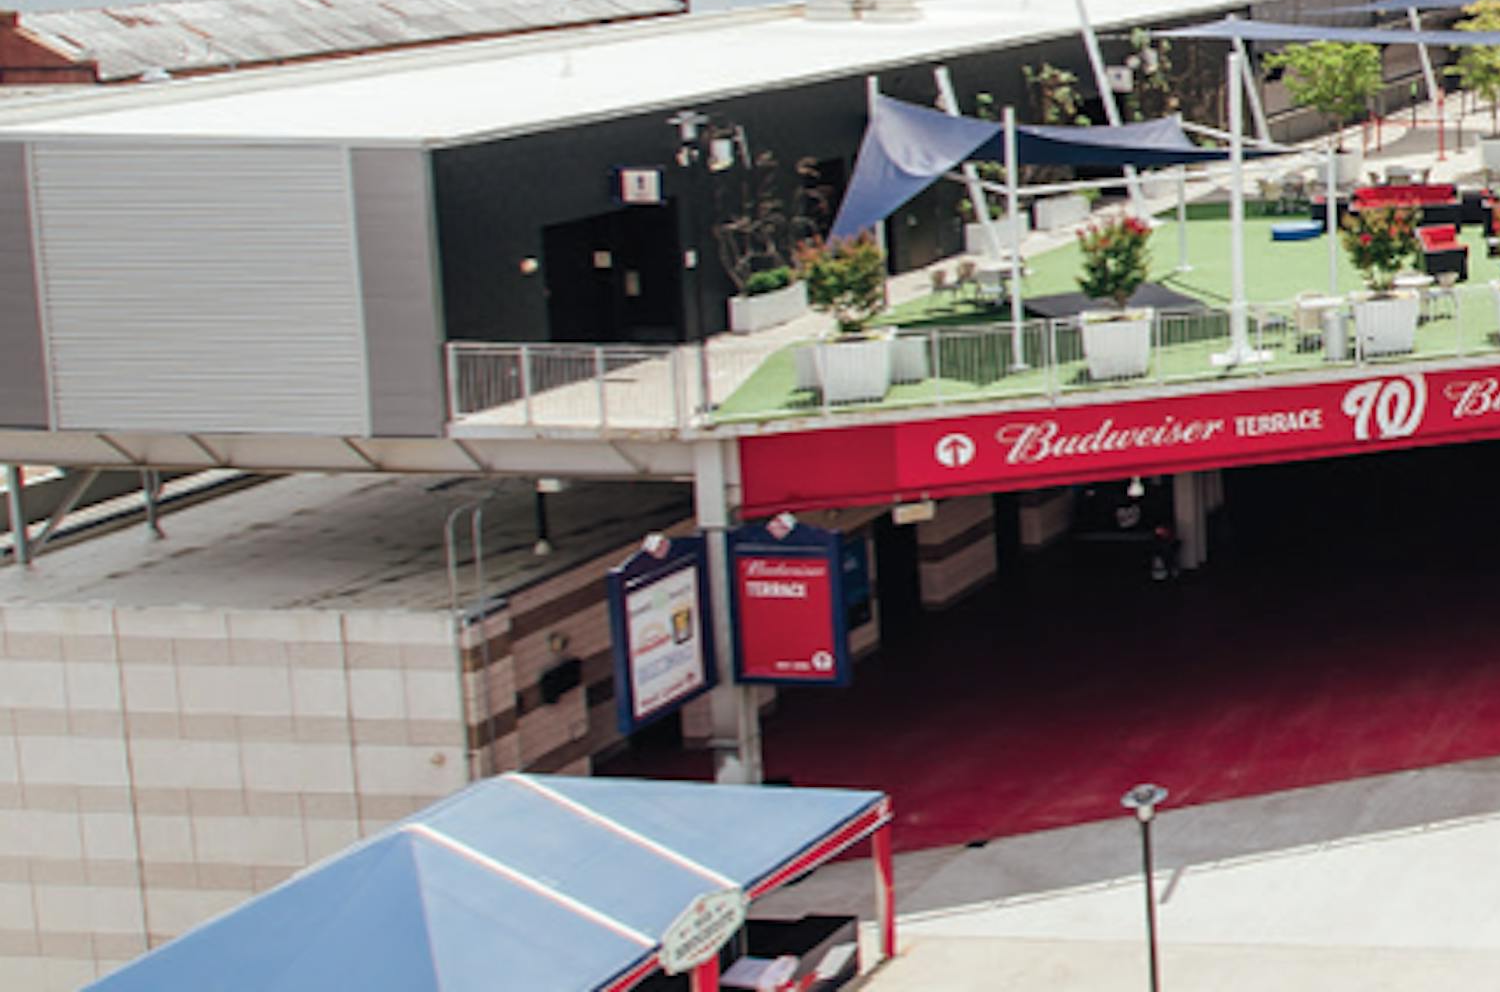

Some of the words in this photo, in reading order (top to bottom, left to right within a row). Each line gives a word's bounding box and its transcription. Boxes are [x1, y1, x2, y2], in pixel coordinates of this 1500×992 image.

[1342, 375, 1427, 440] W
[995, 415, 1222, 466] Budweiser
[1234, 408, 1324, 438] TERRACE
[746, 581, 806, 598] TERRACE
